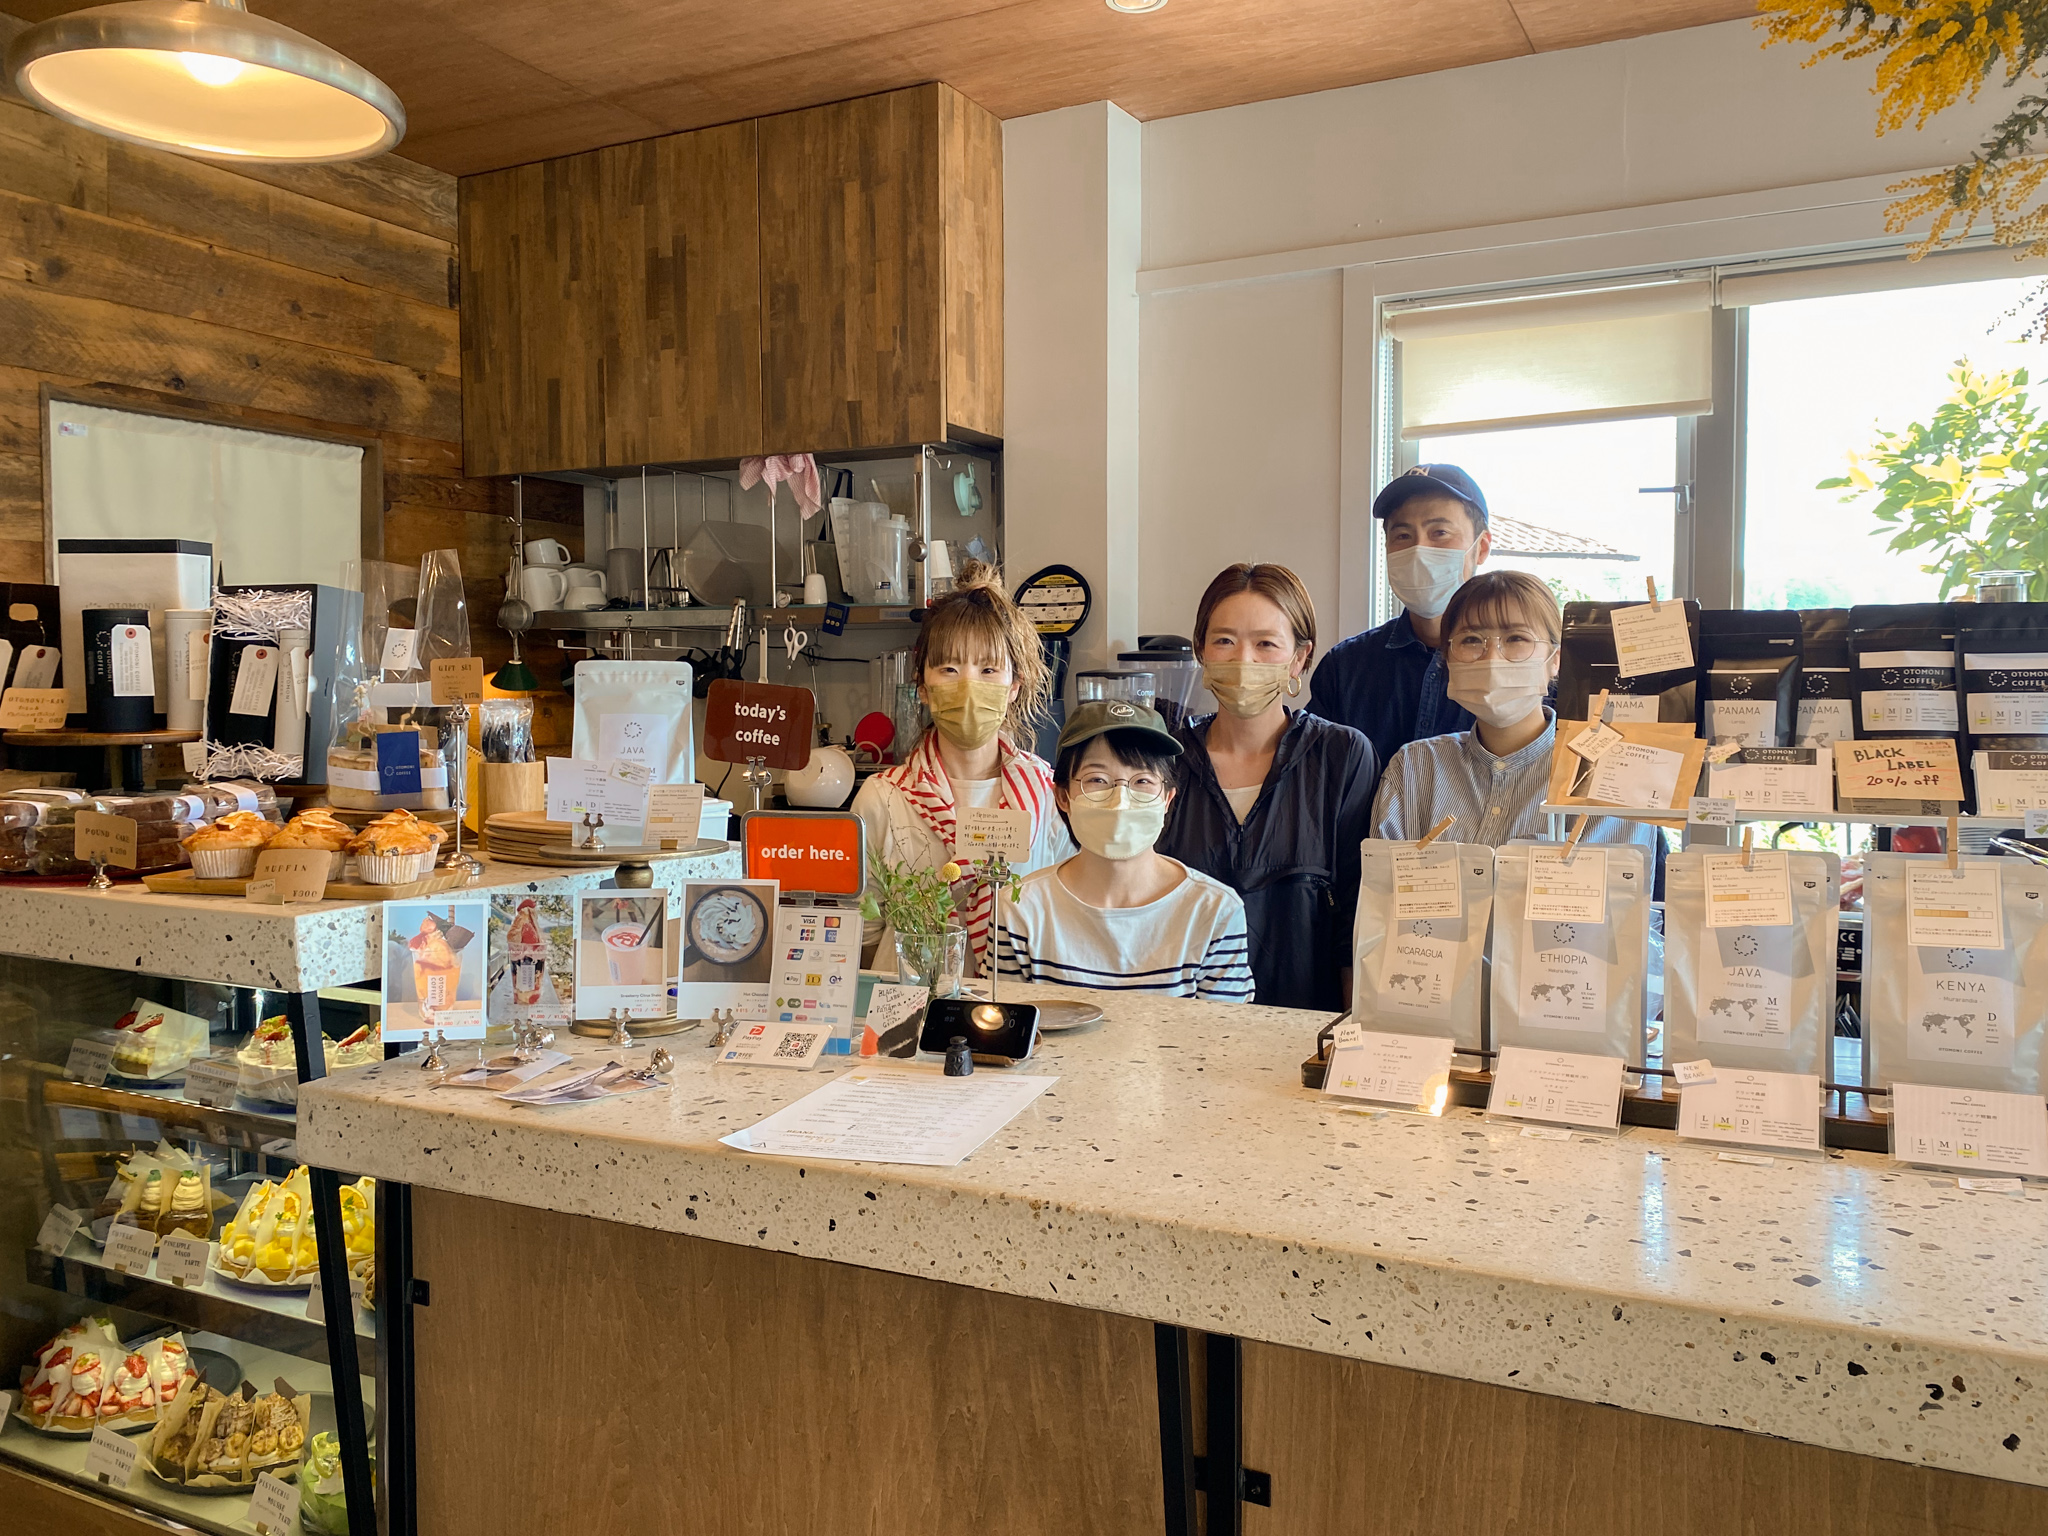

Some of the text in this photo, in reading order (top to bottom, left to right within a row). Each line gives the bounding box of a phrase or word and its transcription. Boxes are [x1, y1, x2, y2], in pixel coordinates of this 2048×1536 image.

[438, 664, 456, 672] GIFT
[2011, 679, 2047, 687] COFFEE
[734, 702, 787, 723] today's
[1718, 706, 1761, 715] PANAMA
[735, 729, 781, 746] coffee
[1839, 730, 1846, 738] L
[1625, 751, 1650, 760] COFFEE
[1626, 745, 1659, 756] OTOMONI
[1853, 747, 1905, 763] BLACK
[1887, 759, 1937, 772] LABEL
[1914, 774, 1940, 786] off
[1651, 790, 1659, 799] L
[85, 828, 110, 838] POUND
[761, 845, 850, 861] order here.
[264, 864, 308, 873] MUFFIN
[1396, 945, 1443, 959] NICARAGUA
[1540, 953, 1588, 965] ETHIOPIA
[1728, 967, 1762, 978] JAVA
[1435, 974, 1441, 982] L
[1586, 982, 1592, 990] L
[1936, 979, 1986, 993] KENYA
[878, 987, 898, 998] BLACK
[1767, 997, 1777, 1005] M
[1988, 1012, 1997, 1021] D
[1919, 1138, 1926, 1146] L
[163, 1239, 192, 1250] PINEAPPLE
[184, 1259, 201, 1267] TARTE
